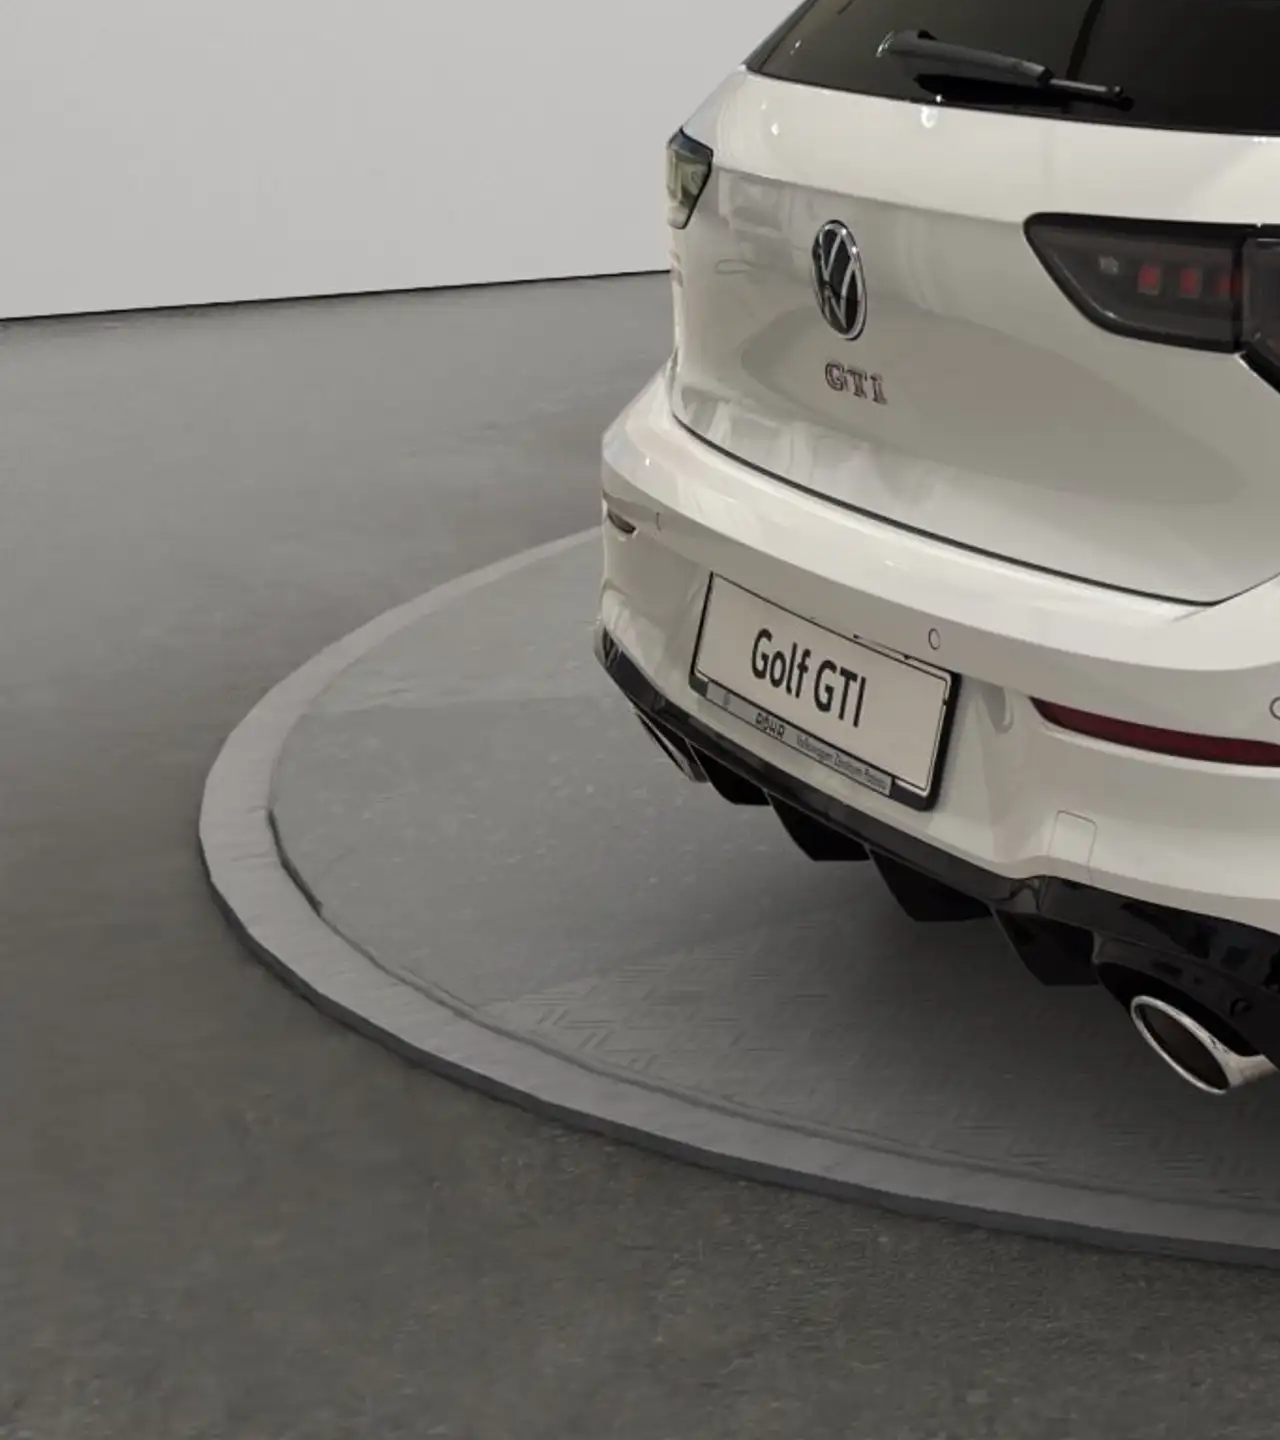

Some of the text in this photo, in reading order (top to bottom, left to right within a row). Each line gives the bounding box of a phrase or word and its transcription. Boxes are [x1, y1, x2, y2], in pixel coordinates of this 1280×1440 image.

[825, 361, 887, 405] GTI
[751, 628, 867, 728] Golf GTI
